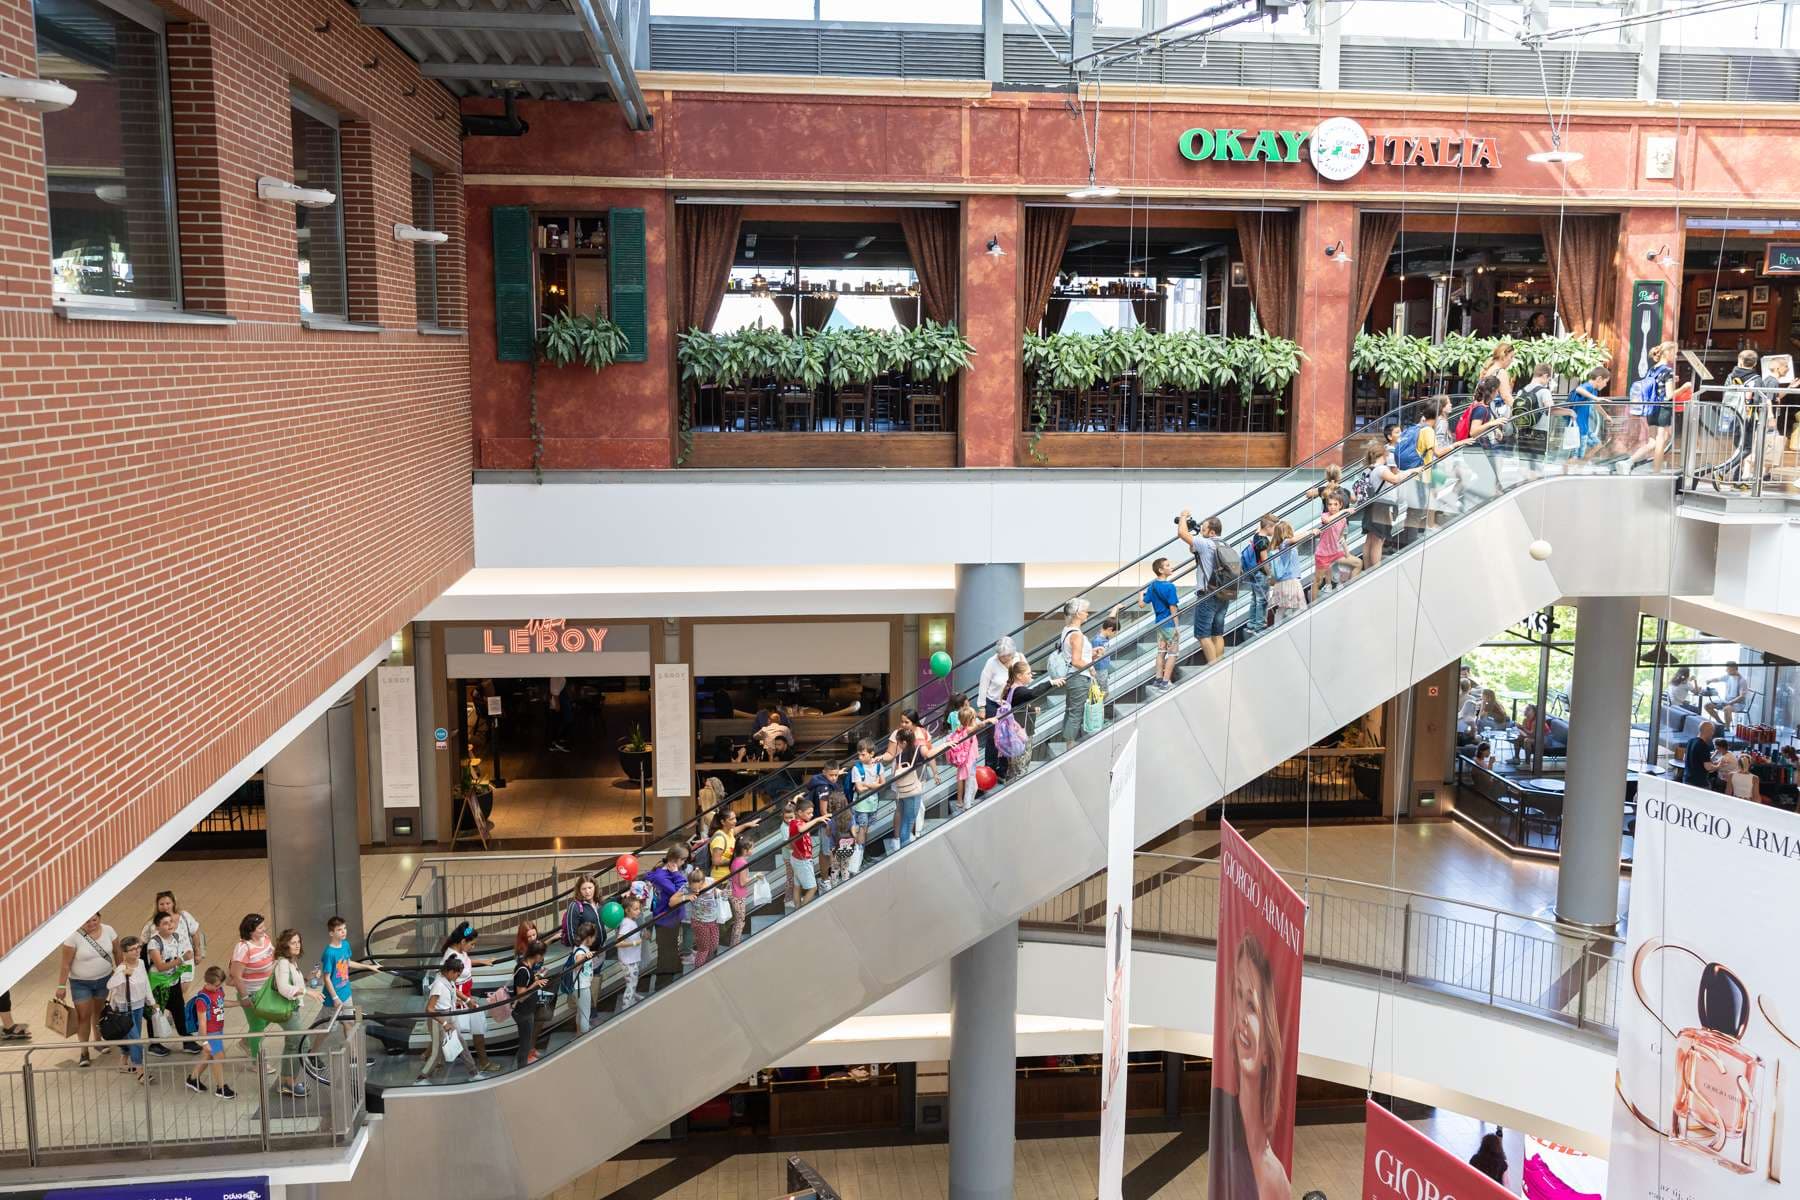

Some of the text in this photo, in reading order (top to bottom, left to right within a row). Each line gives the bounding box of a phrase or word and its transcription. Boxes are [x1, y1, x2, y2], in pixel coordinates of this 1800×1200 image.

[1179, 128, 1310, 163] OKAY
[1371, 135, 1502, 168] ITALIA
[483, 627, 608, 654] LEROY
[1645, 798, 1731, 840] GIORGIO
[1223, 850, 1300, 956] GIORGIO ARMANI
[1374, 1149, 1456, 1200] GIOR
